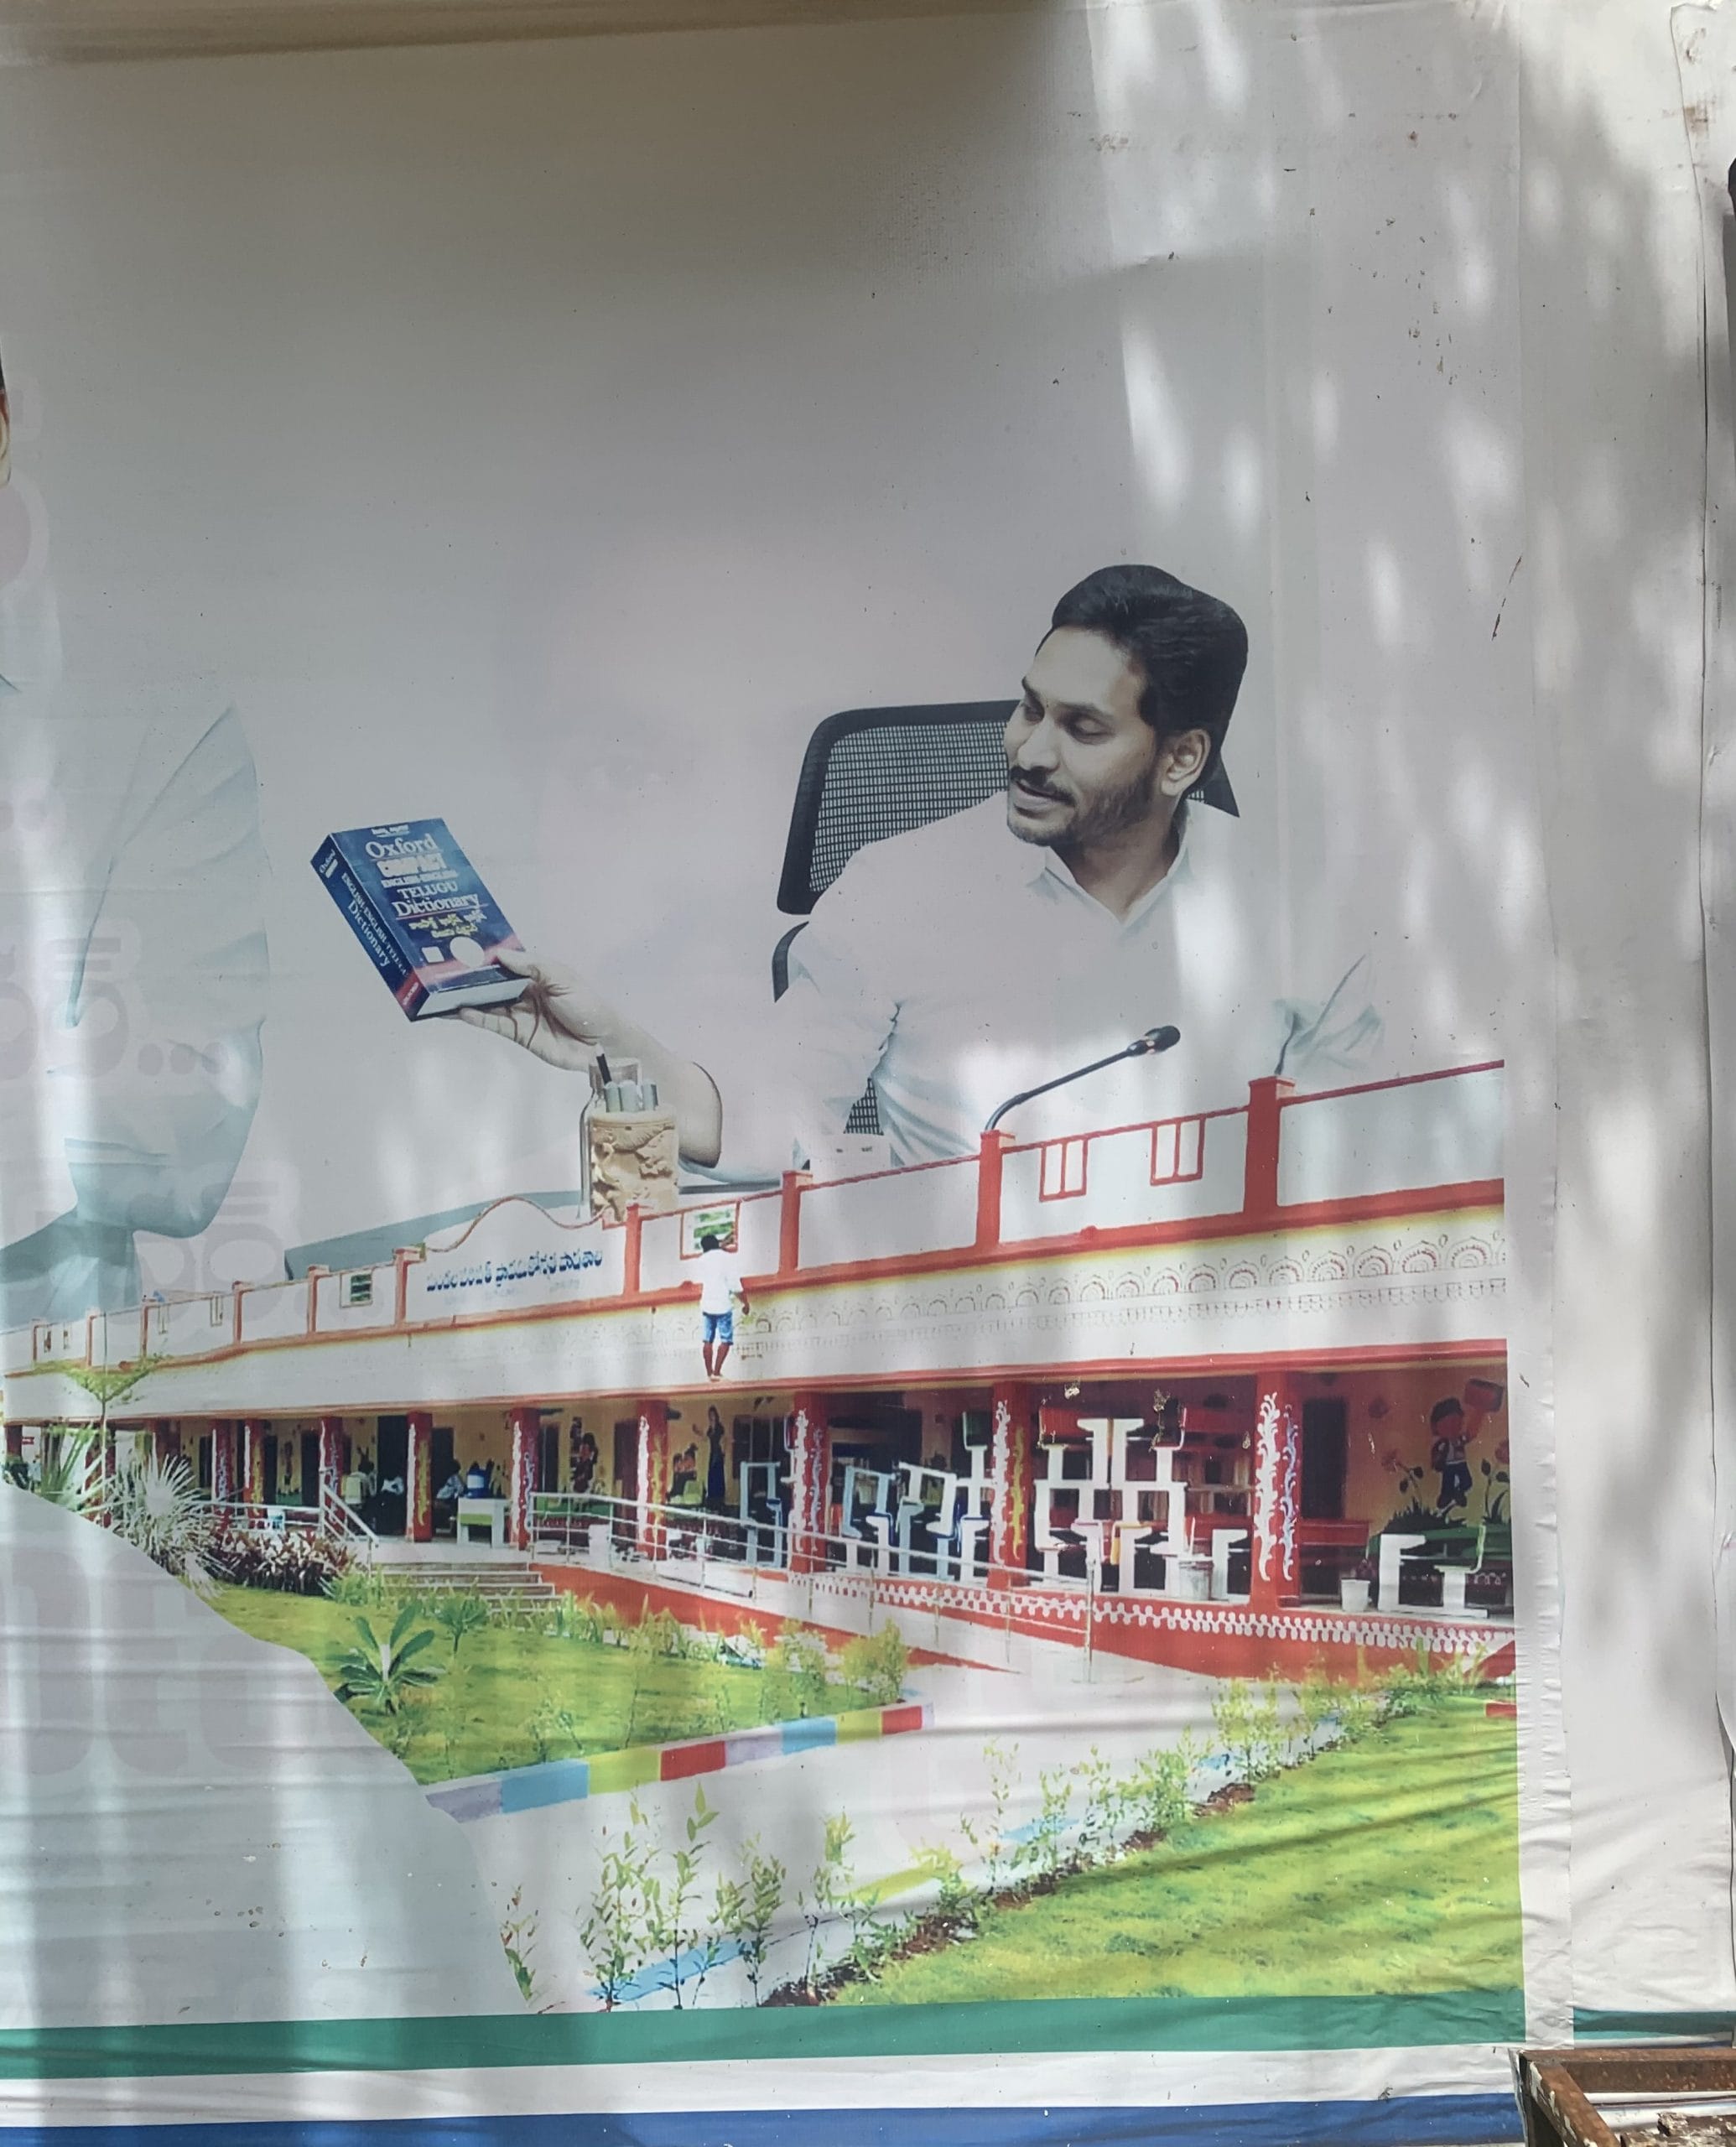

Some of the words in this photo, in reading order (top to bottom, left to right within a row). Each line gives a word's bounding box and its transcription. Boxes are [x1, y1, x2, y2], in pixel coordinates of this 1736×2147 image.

[366, 833, 439, 859] Oxford
[397, 881, 458, 899] TELUGU
[392, 893, 481, 917] Dictionary
[348, 901, 391, 967] Dictionary
